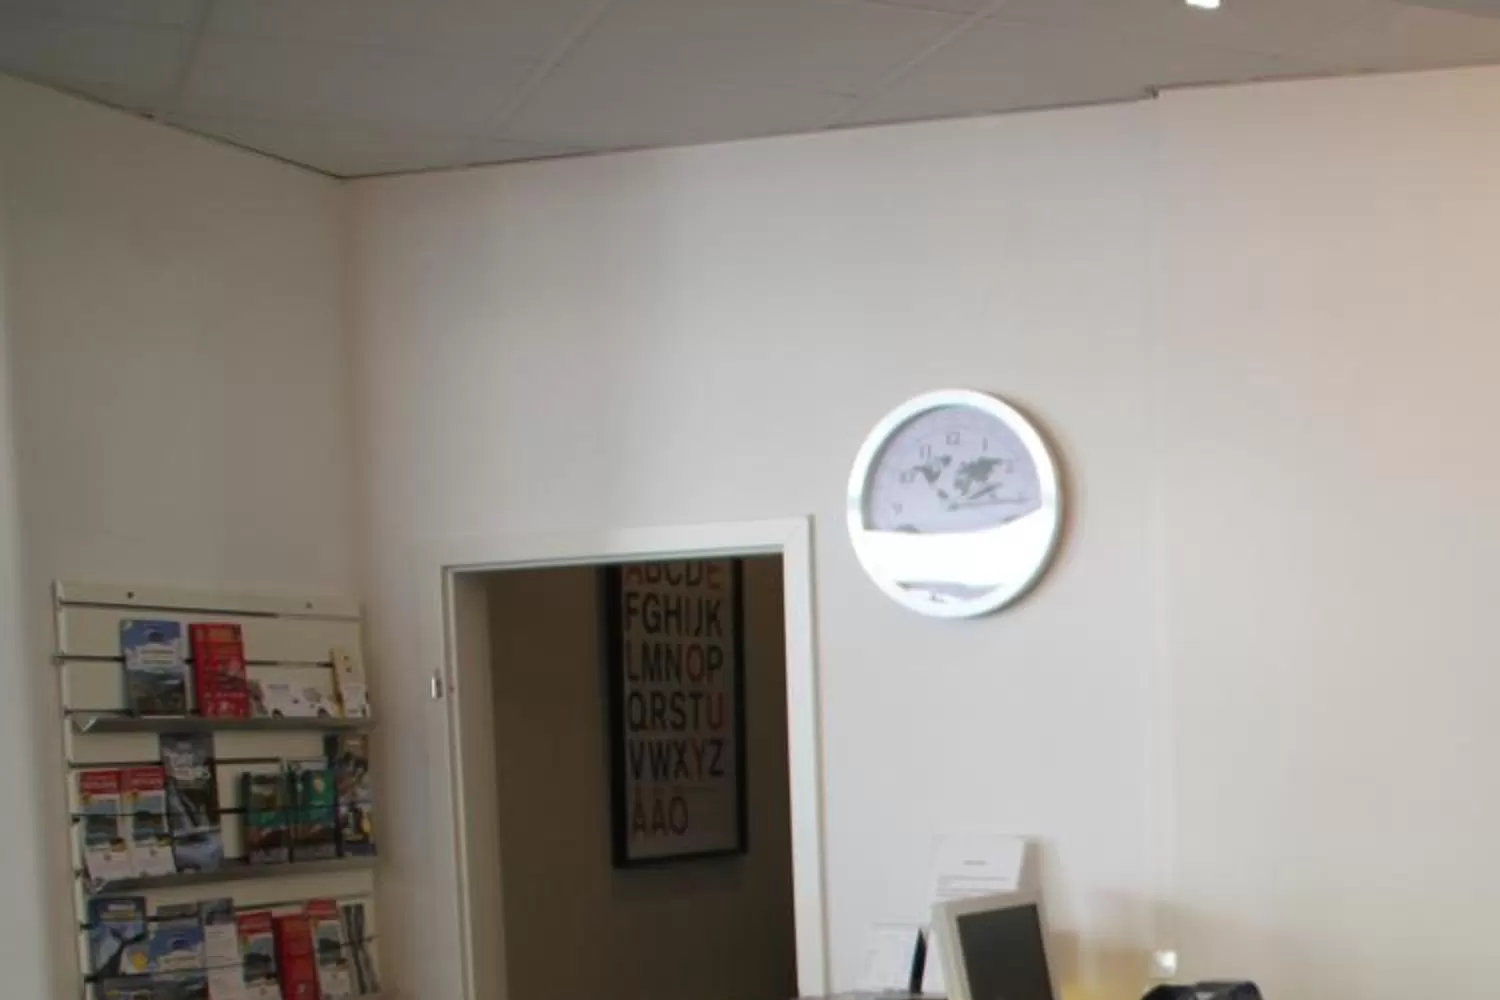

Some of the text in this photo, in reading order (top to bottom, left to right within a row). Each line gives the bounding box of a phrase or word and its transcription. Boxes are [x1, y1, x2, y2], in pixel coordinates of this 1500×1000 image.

[624, 591, 723, 637] FGHIJK
[625, 640, 724, 683] LMNOP
[627, 691, 725, 732] QRSTU
[629, 738, 725, 781] VWXYZ
